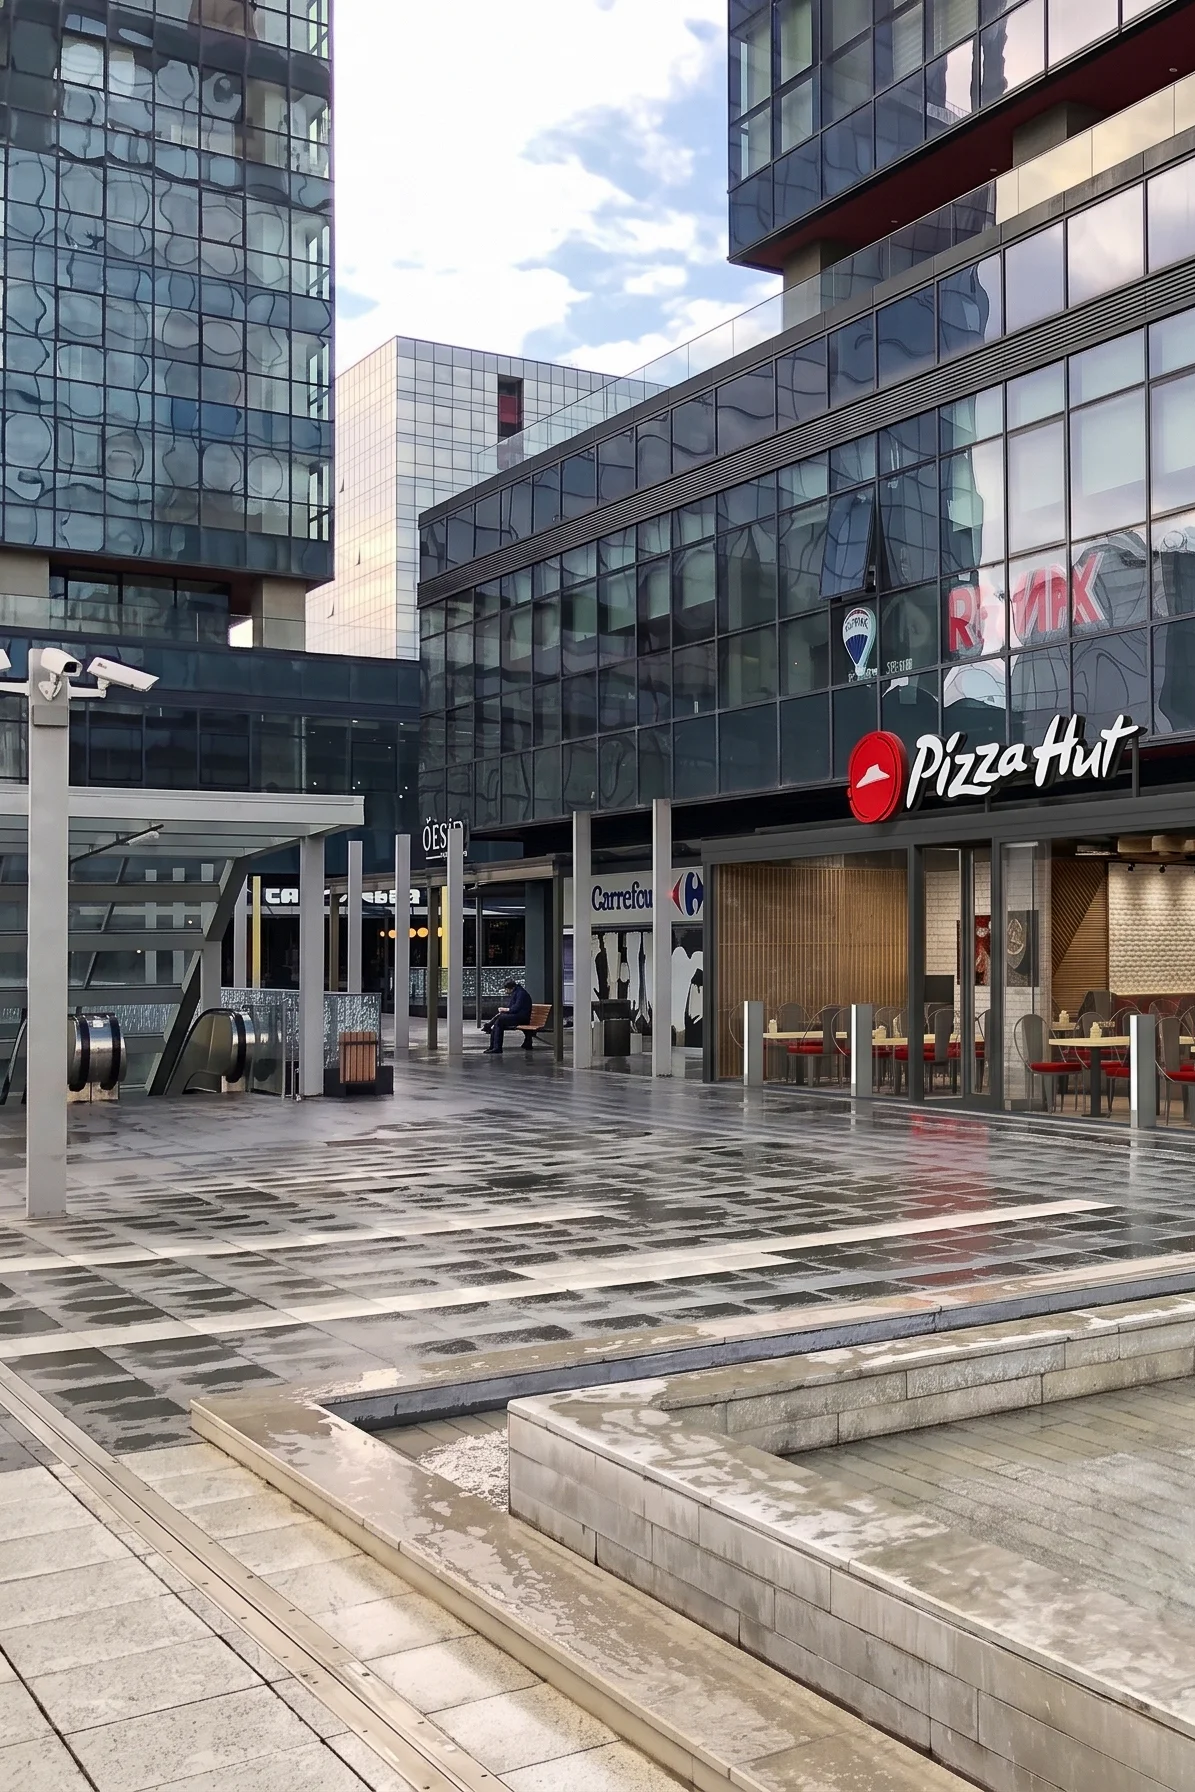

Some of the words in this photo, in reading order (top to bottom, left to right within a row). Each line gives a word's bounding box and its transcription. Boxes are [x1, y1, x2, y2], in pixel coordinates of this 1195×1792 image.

[906, 731, 1028, 809] Pizza
[1032, 713, 1140, 788] Hut
[591, 880, 653, 911] Carrefou
